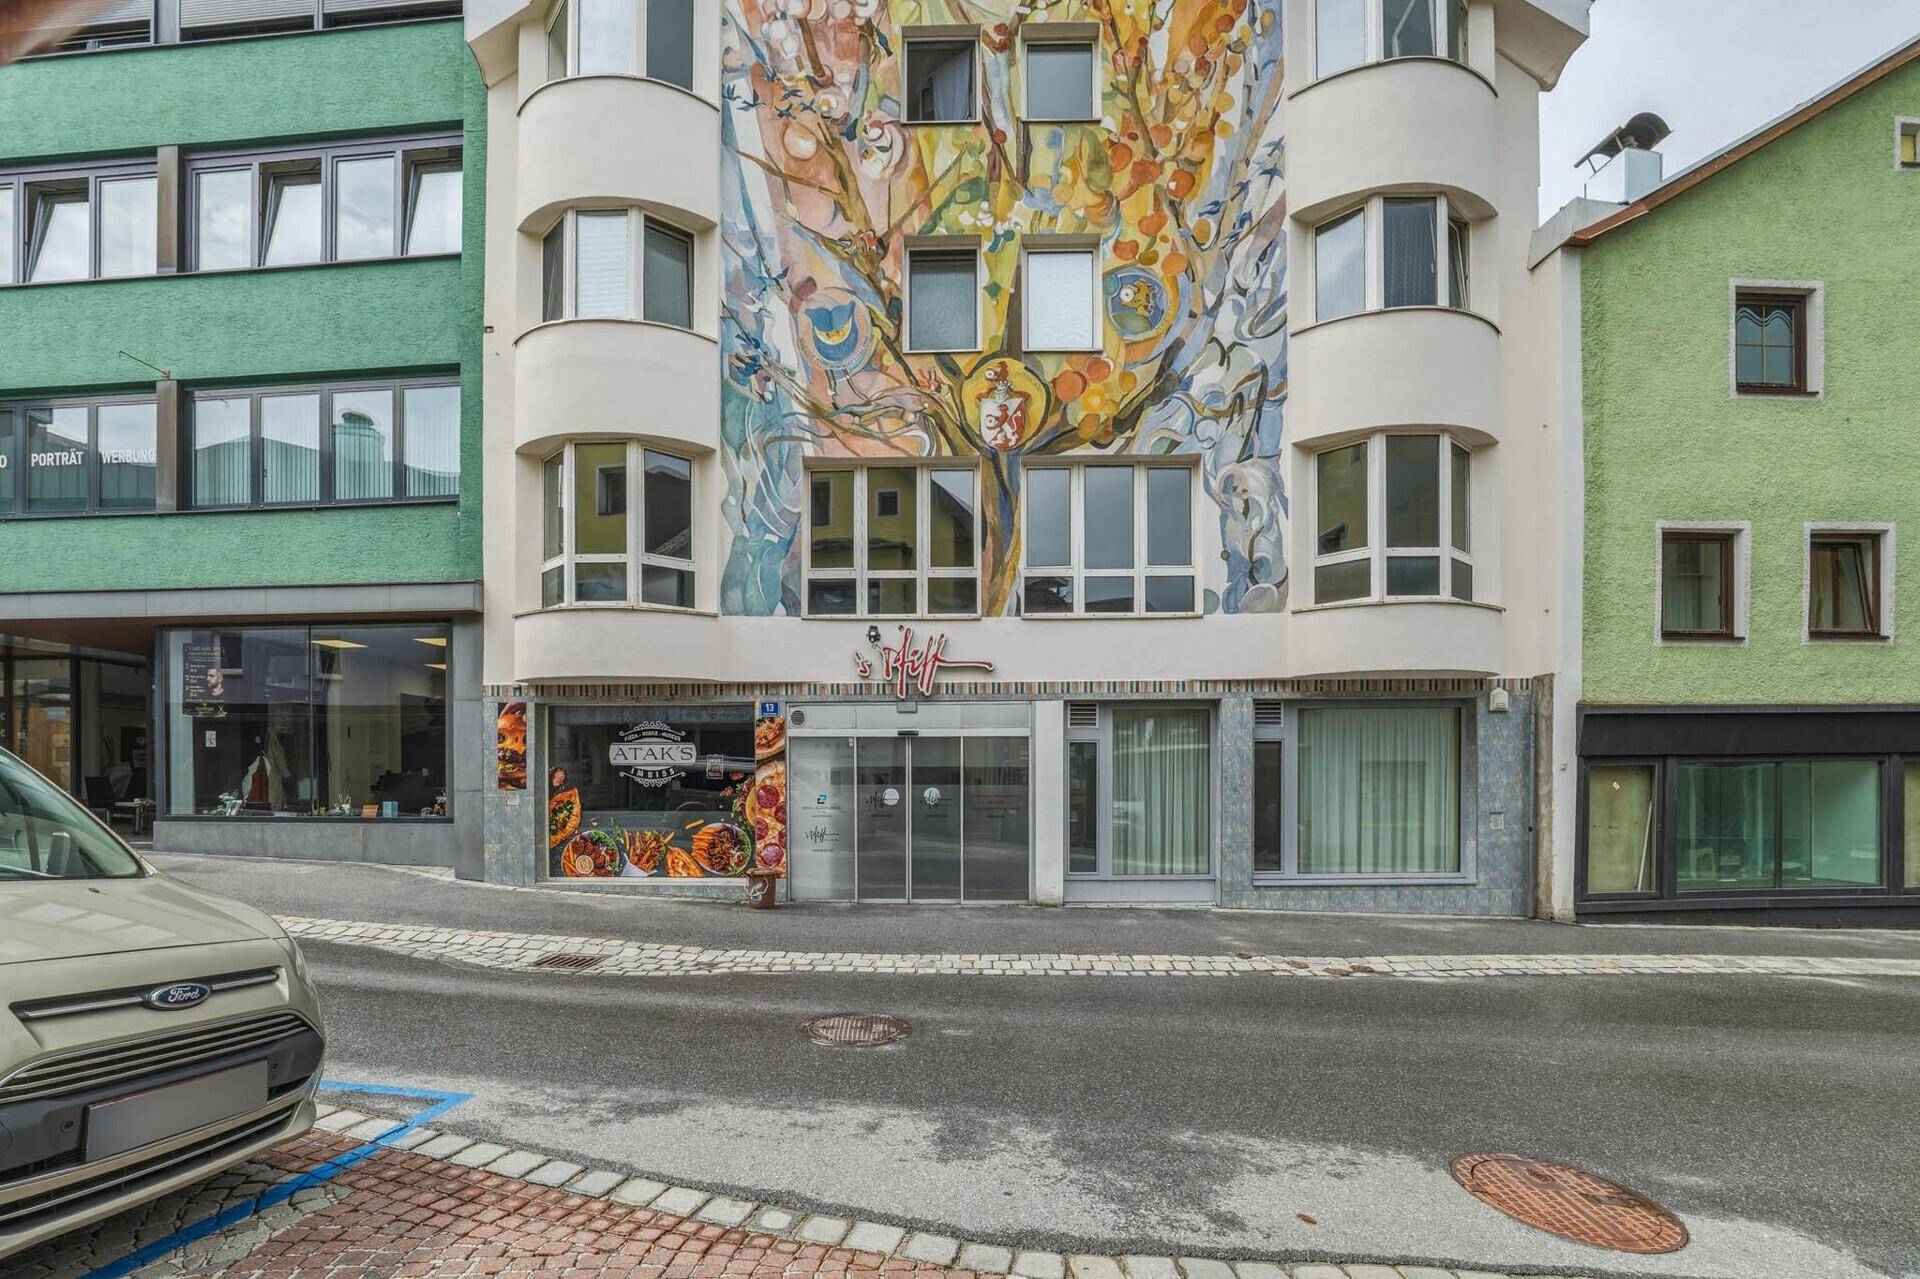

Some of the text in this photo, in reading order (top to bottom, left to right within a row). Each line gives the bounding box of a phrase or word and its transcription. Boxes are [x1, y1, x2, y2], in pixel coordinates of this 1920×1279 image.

[31, 449, 84, 467] PORTRÄT
[101, 449, 157, 464] WERBUNG
[765, 703, 775, 712] 13
[168, 986, 200, 1003] Ford
